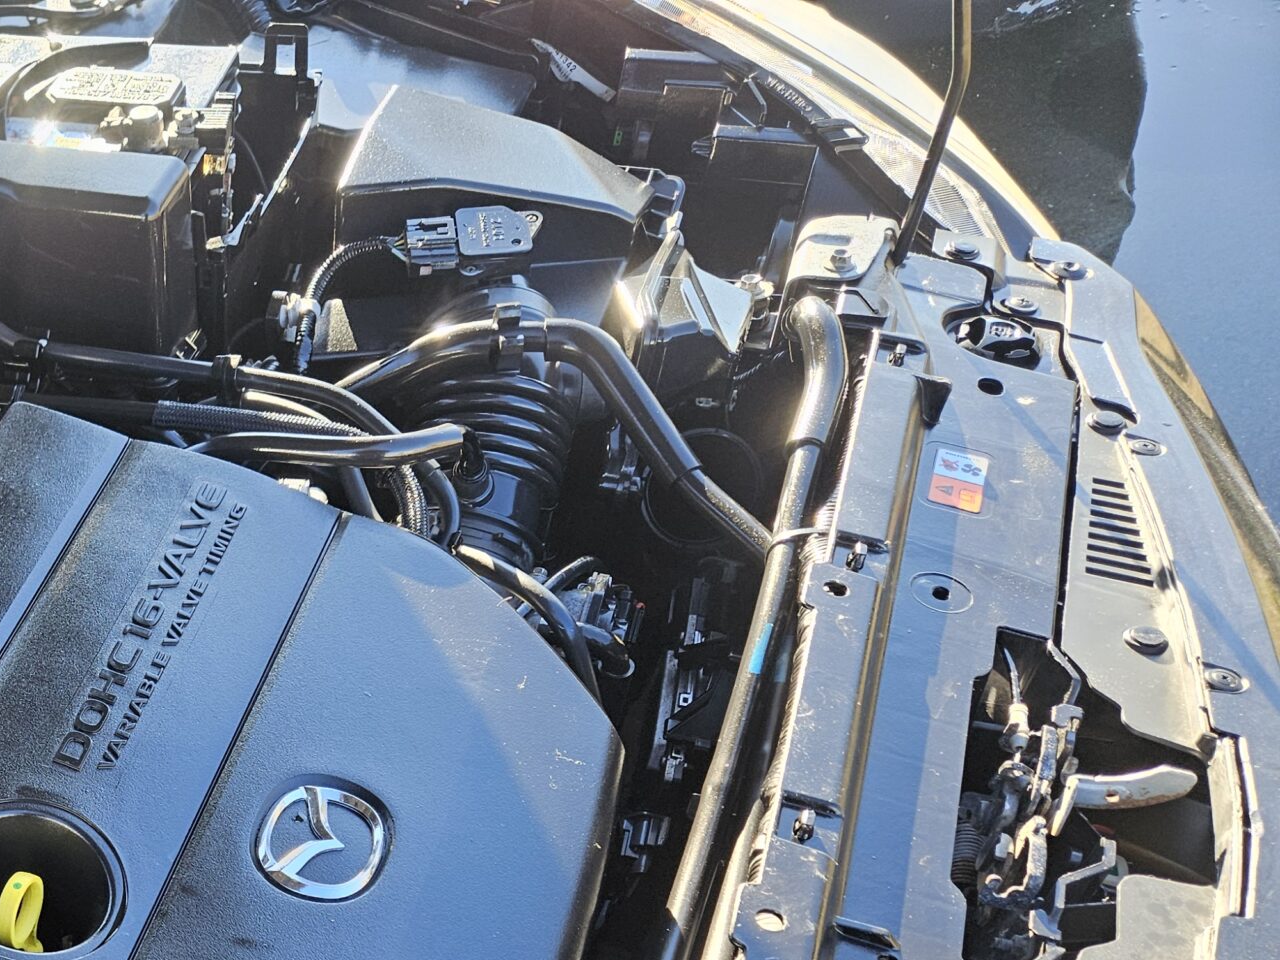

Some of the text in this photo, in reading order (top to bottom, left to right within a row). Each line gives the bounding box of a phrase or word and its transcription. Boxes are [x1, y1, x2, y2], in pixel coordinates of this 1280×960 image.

[52, 481, 228, 772] DOHC 16-VALVE
[97, 503, 248, 770] VARIABLE VALVE TIMING
